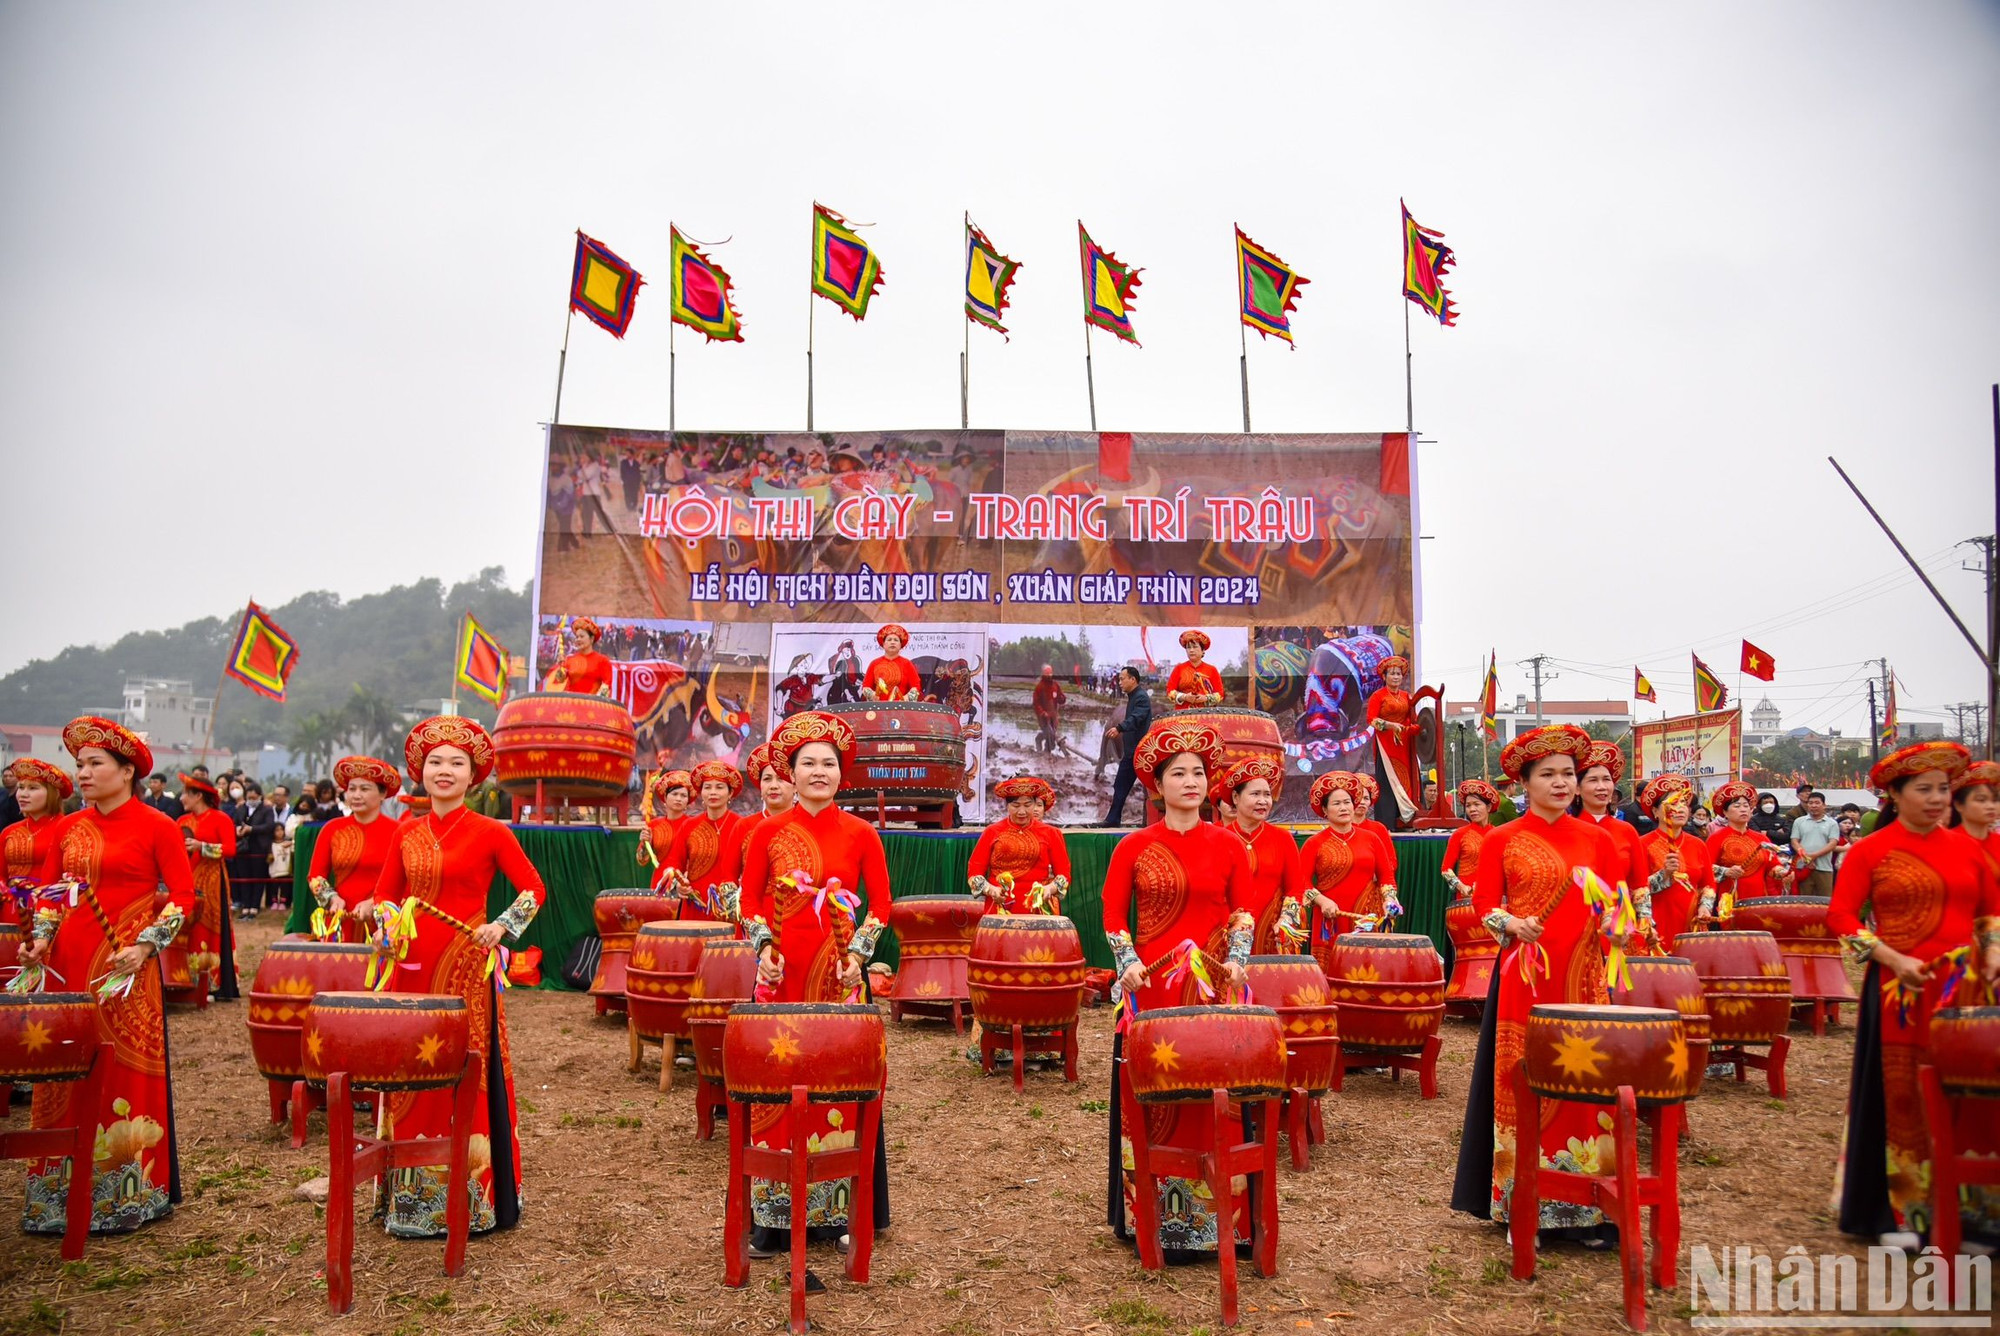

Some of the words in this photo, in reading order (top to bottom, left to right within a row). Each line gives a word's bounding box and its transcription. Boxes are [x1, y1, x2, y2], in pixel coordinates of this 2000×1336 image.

[639, 484, 732, 549] HỘI
[750, 494, 815, 540] THI
[833, 484, 918, 540] CÀY
[969, 492, 1107, 541] TRANG
[1122, 485, 1191, 542] TRÍ
[1204, 485, 1315, 543] TRÂU
[690, 563, 721, 601] LỄ
[726, 569, 769, 608] HỘI
[774, 573, 827, 608] TỊCH
[833, 564, 888, 601] ĐIỀN
[894, 573, 935, 608] ĐỌI
[1008, 569, 1074, 603] XUÂN
[1080, 570, 1131, 603] GIÁP
[1137, 571, 1193, 604] THÌN
[1200, 576, 1260, 604] 2024
